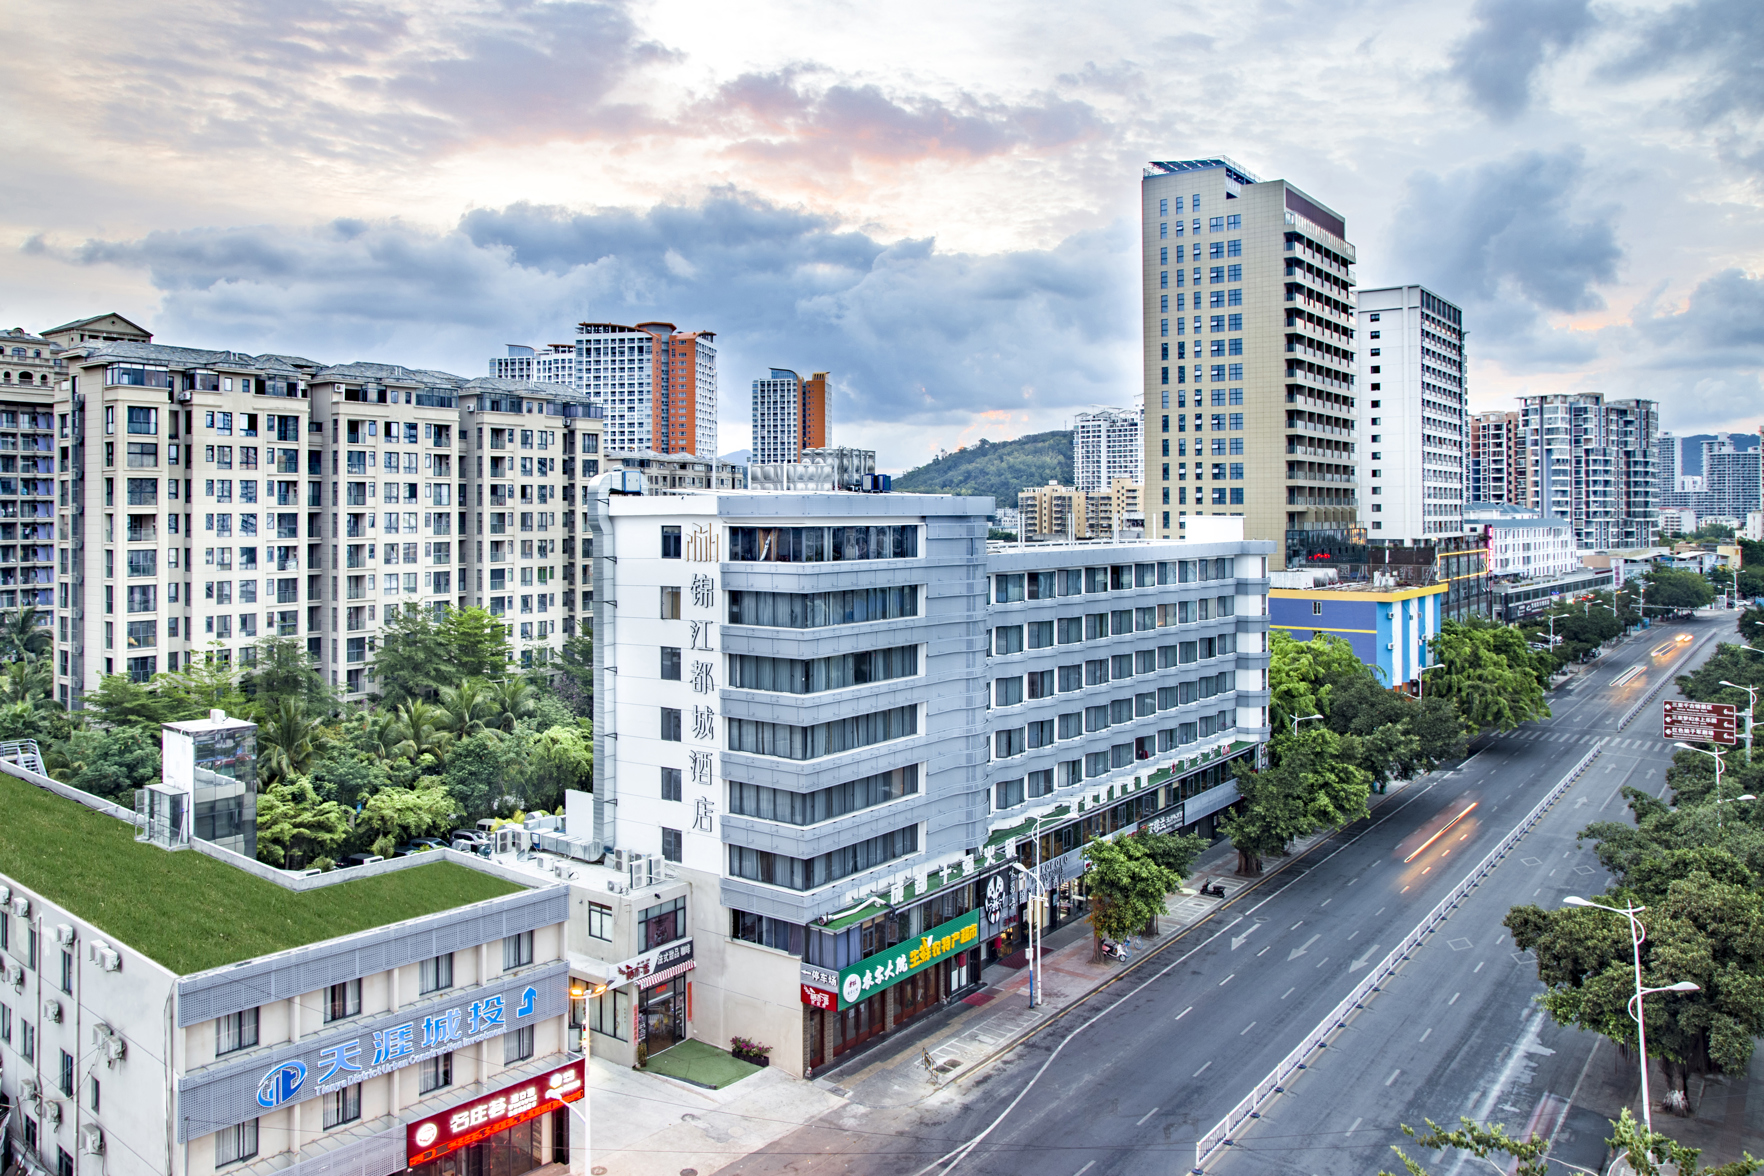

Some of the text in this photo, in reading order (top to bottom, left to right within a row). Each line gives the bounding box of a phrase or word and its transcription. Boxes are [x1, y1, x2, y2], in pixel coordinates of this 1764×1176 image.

[690, 573, 714, 833] 锦江都城酒店
[657, 947, 680, 965] 法式甜品
[909, 923, 978, 969] 生鲜农特产超市
[812, 968, 838, 987] 停车场
[314, 1024, 508, 1096] Tianya District Urban Construction Investment
[318, 994, 505, 1084] 天涯城投
[450, 1097, 507, 1133] 名庄荟
